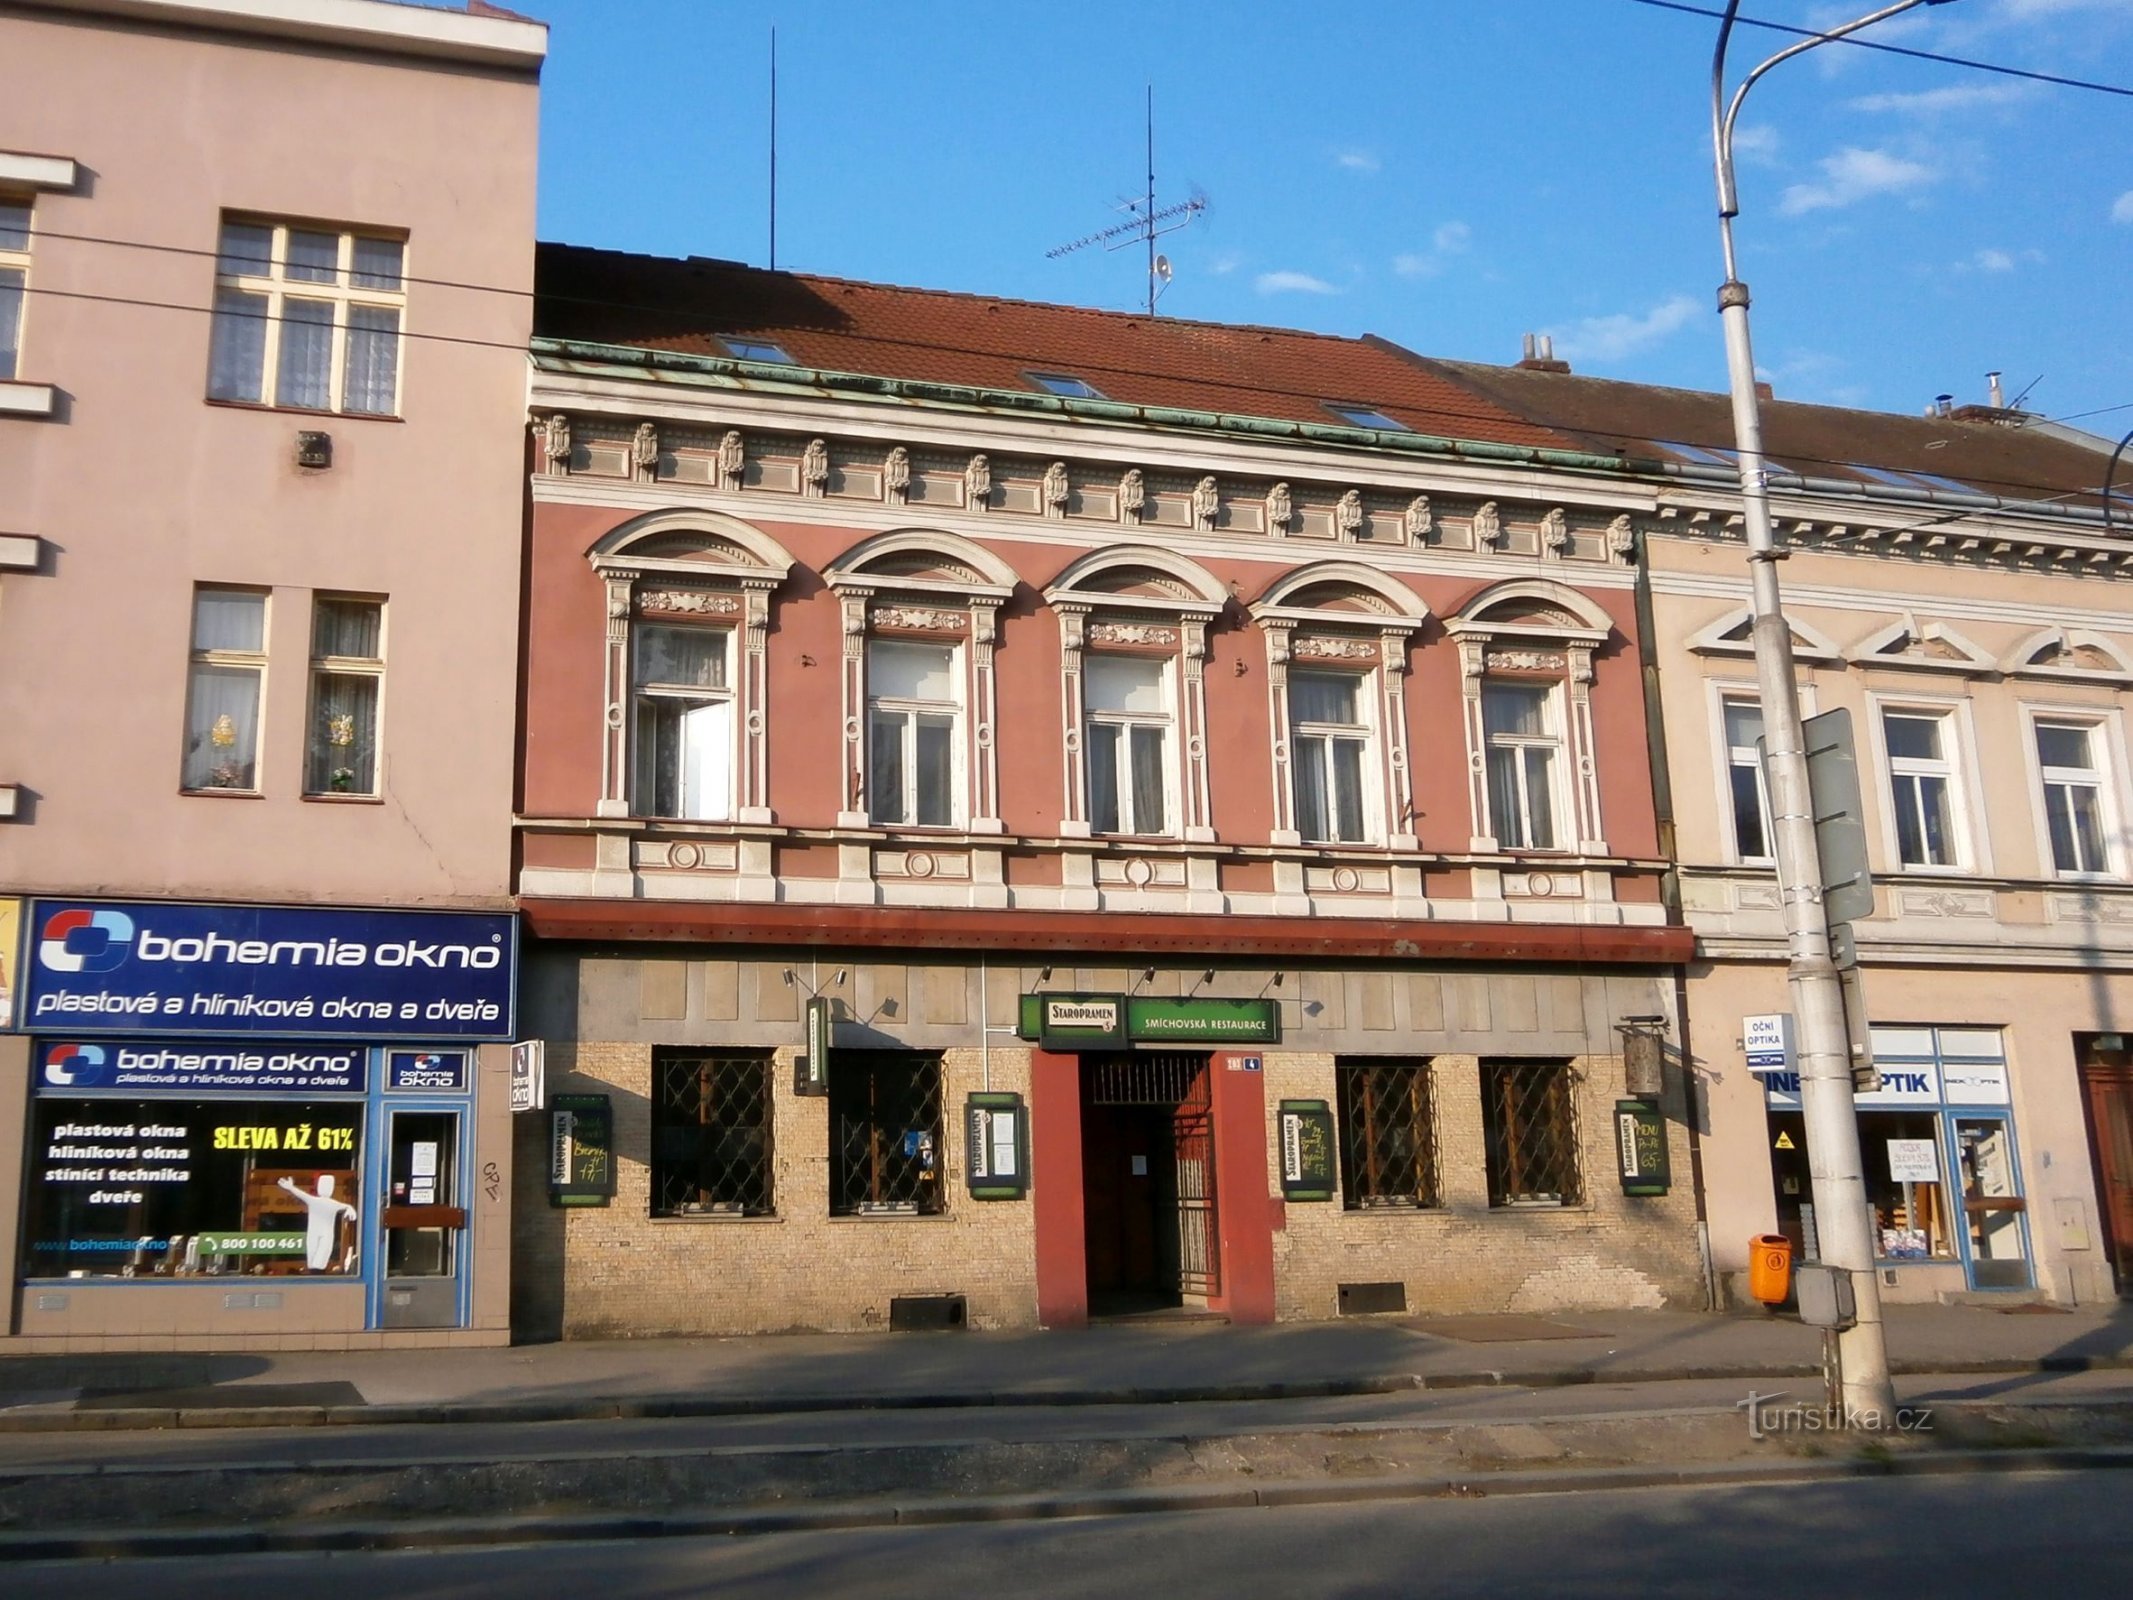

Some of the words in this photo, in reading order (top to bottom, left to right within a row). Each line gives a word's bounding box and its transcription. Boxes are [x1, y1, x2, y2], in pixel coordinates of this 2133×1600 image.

[137, 930, 367, 967] bohemia
[35, 989, 157, 1016] plastová
[163, 997, 183, 1014] a
[190, 992, 314, 1017] hliníková
[321, 996, 393, 1018] okna
[400, 1002, 418, 1019] a
[425, 998, 499, 1020] dveře
[1052, 1005, 1113, 1019] STAROPRAMEN
[1145, 1017, 1207, 1029] SMÍCHOVSKÁ
[1211, 1020, 1267, 1030] RESTAURACE
[1752, 1021, 1774, 1031] OČNÍ
[1747, 1035, 1780, 1045] OPTIKA
[117, 1049, 264, 1071] bohemia
[257, 1074, 294, 1085] okna
[297, 1077, 307, 1085] a
[400, 1077, 454, 1086] okno
[1765, 1073, 1801, 1091] INE
[1881, 1073, 1930, 1092] PTIK
[54, 1123, 135, 1139] plastová
[139, 1124, 187, 1137] okna
[213, 1127, 278, 1150] SLEVA
[283, 1123, 312, 1150] AŽ
[318, 1128, 353, 1150] 61%
[48, 1145, 137, 1159] hliníková
[142, 1147, 189, 1159] okna
[109, 1168, 190, 1181] technika
[89, 1190, 143, 1203] dveře
[221, 1239, 248, 1250] 800
[251, 1239, 276, 1250] 100
[278, 1239, 302, 1250] 461
